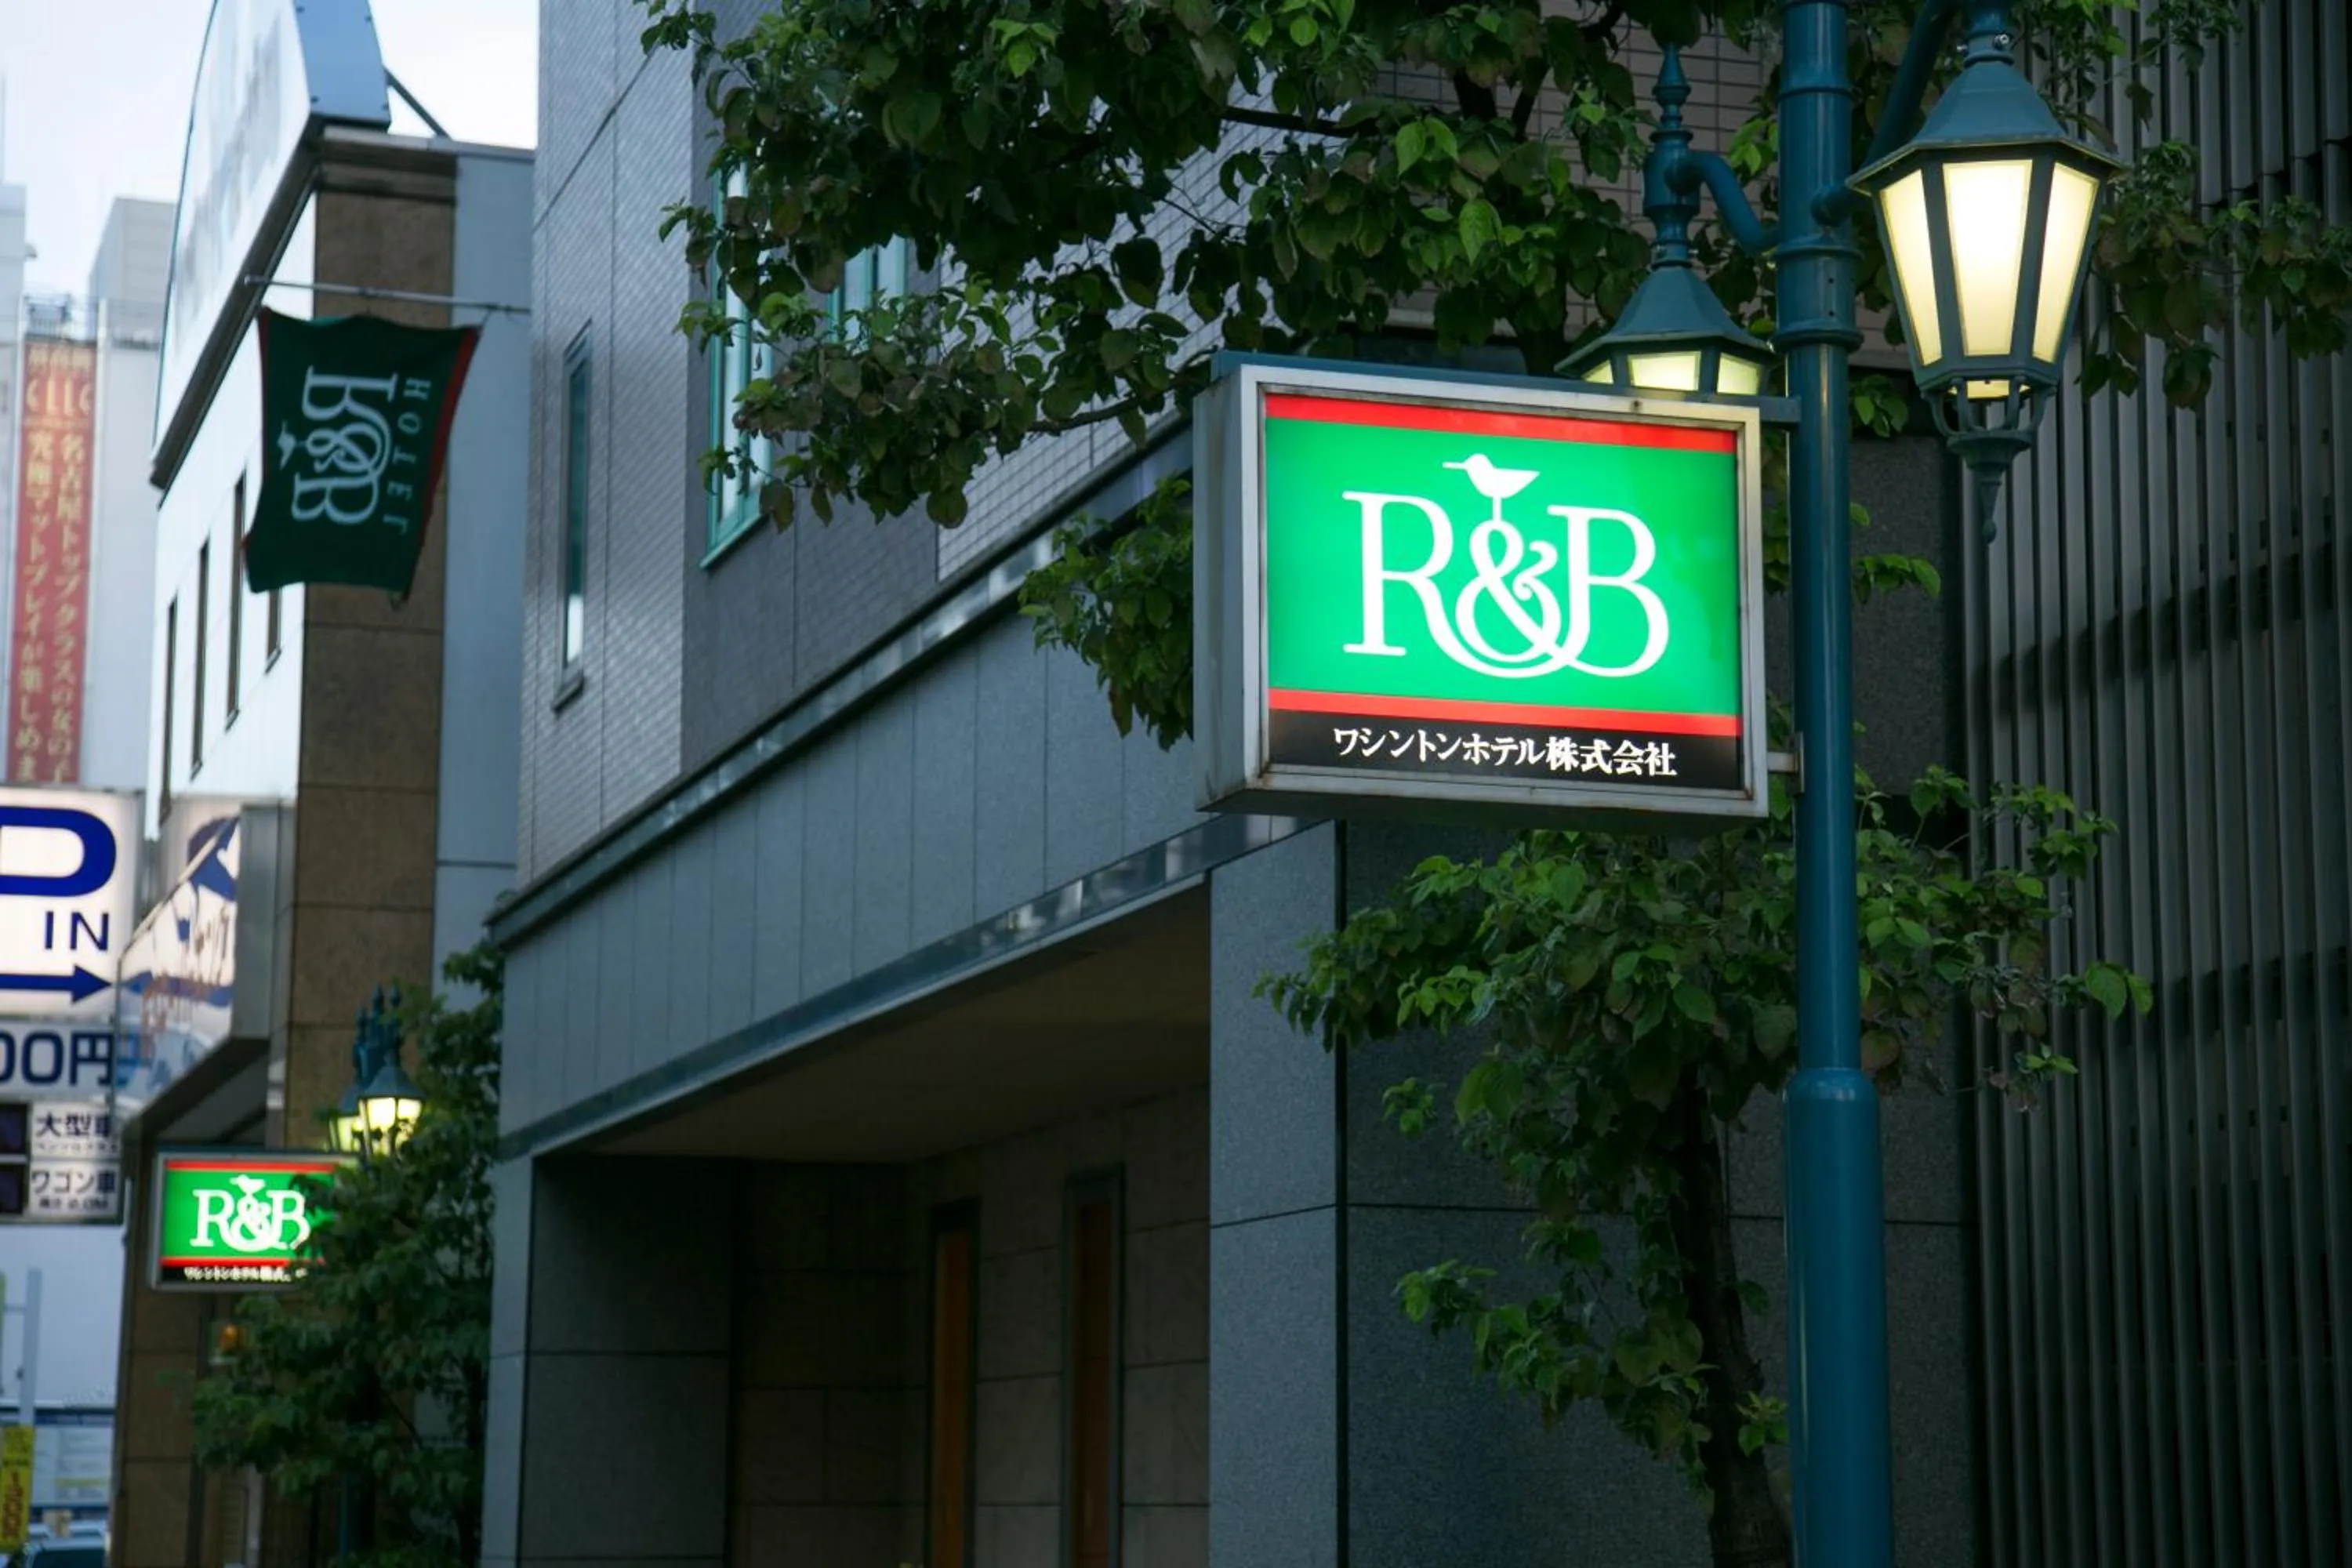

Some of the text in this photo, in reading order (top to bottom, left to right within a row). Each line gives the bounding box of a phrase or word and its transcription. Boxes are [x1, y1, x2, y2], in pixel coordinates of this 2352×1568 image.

[1341, 490, 1669, 678] R&B
[1333, 728, 1678, 777] ワシントンホテル株式会社
[44, 911, 110, 951] IN
[190, 1189, 310, 1251] R&B
